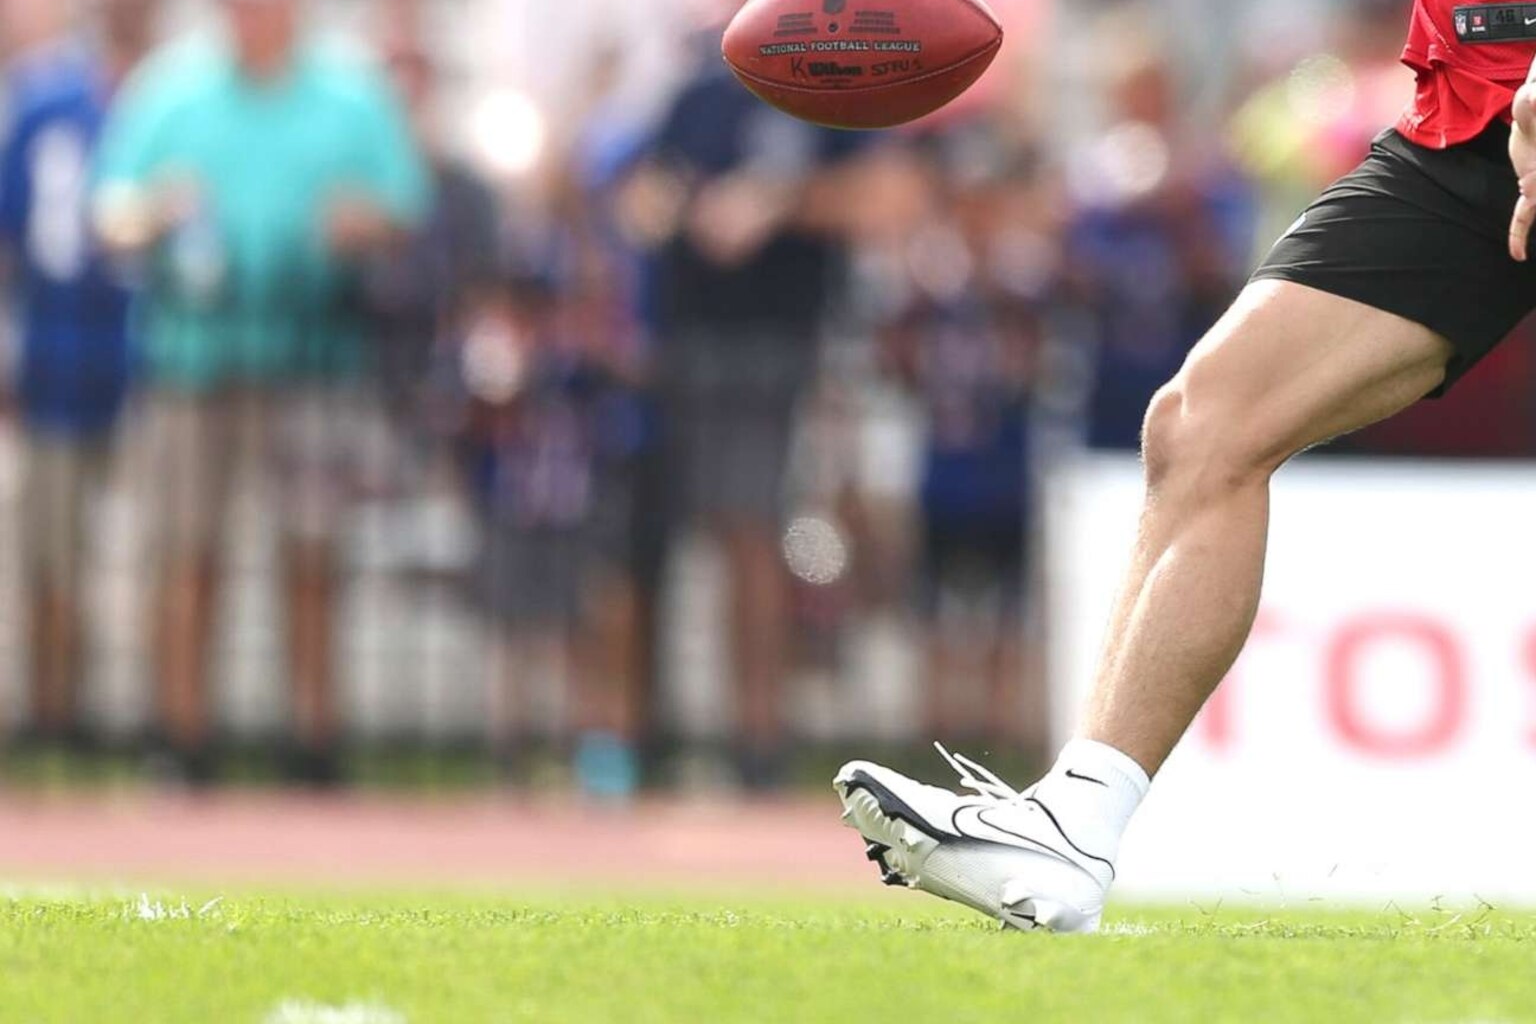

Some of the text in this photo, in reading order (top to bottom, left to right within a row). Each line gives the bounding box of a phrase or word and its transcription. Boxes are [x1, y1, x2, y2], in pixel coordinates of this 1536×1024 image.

[759, 40, 921, 56] NATIONAL FOOTBALL LEAGUE
